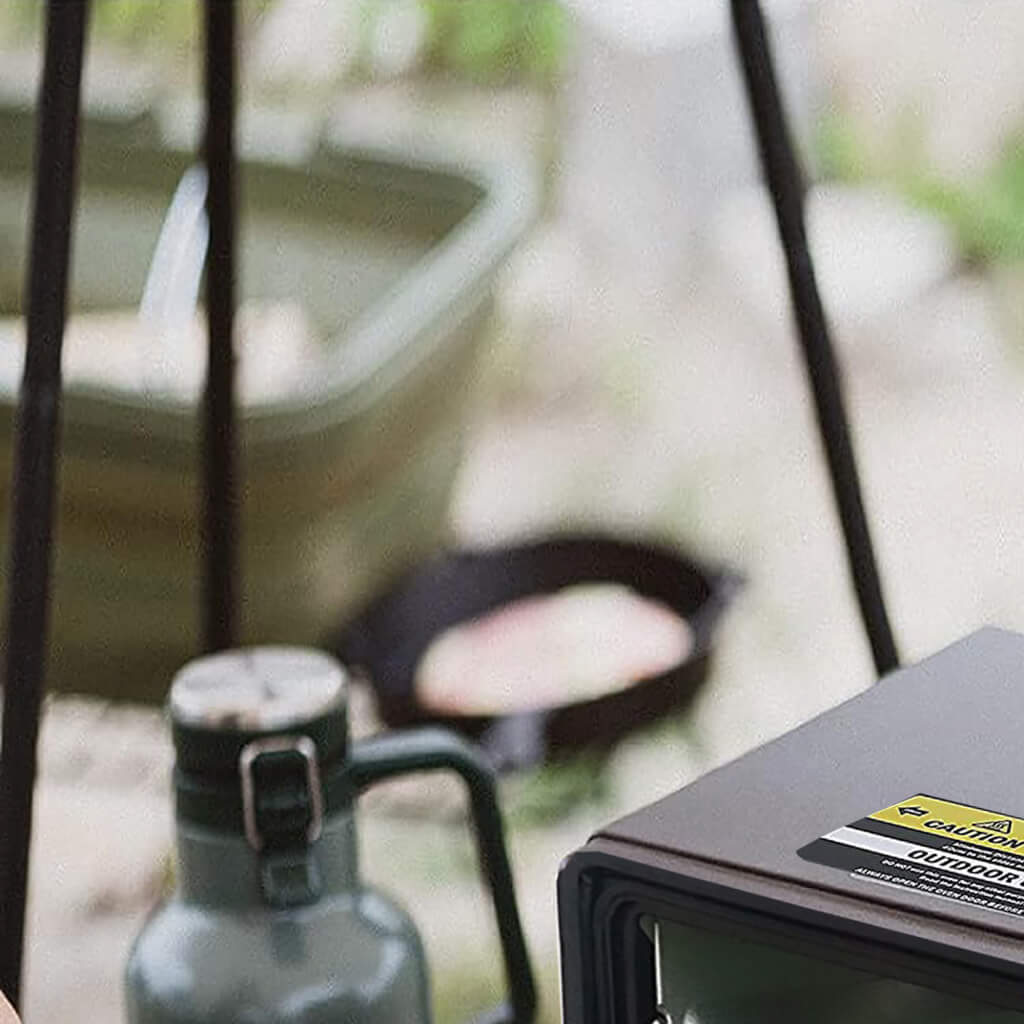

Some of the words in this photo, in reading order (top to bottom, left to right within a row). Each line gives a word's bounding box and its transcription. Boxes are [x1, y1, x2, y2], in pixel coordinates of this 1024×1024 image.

[923, 819, 1024, 849] CAUTION
[907, 850, 1020, 884] OUTDOOR
[854, 866, 893, 881] ALWAYS
[892, 877, 918, 888] OPEN
[917, 883, 936, 893] THE
[987, 901, 1024, 915] BEFORE
